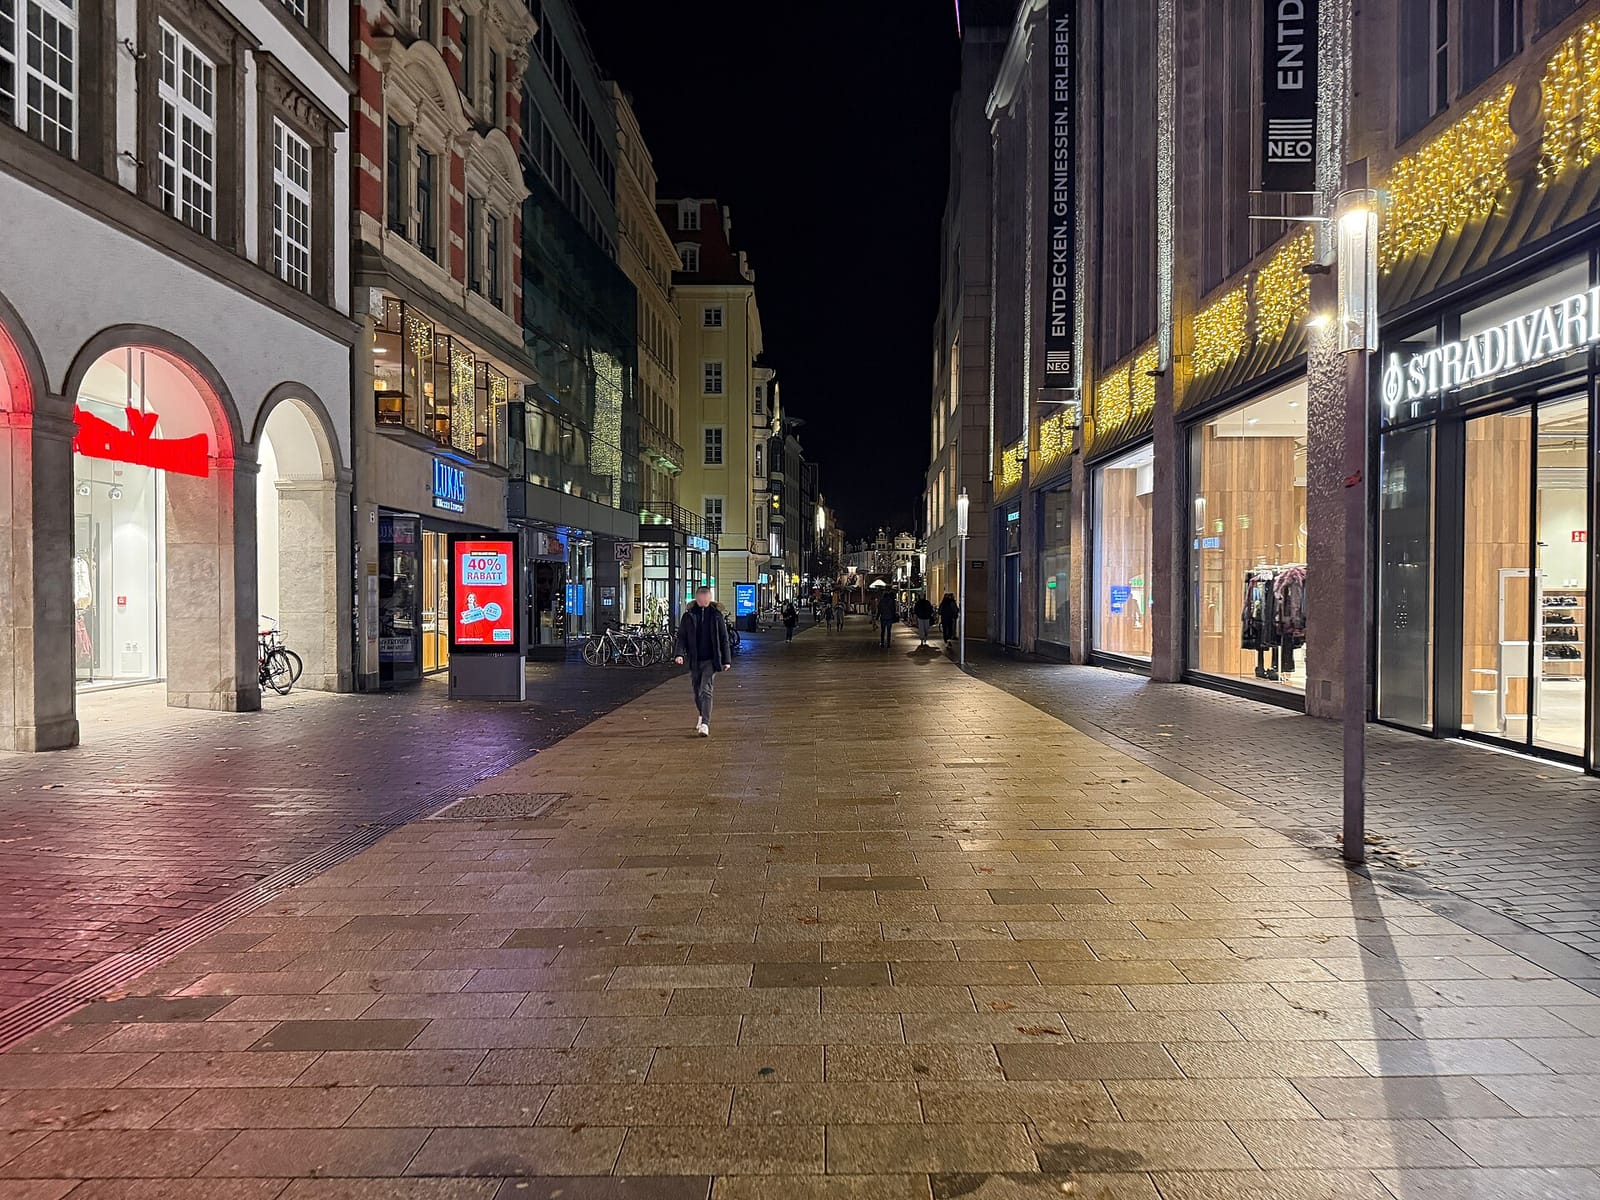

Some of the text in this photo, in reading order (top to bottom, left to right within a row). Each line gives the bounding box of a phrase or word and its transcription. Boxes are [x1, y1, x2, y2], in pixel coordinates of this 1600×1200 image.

[1268, 141, 1313, 157] NEO
[1052, 13, 1069, 337] ENTDECKEN. GENIESSEN. ERLEBEN.
[1046, 362, 1070, 371] NEO
[434, 458, 465, 501] LUKAS
[468, 558, 501, 571] 40%
[467, 572, 503, 580] RABATT
